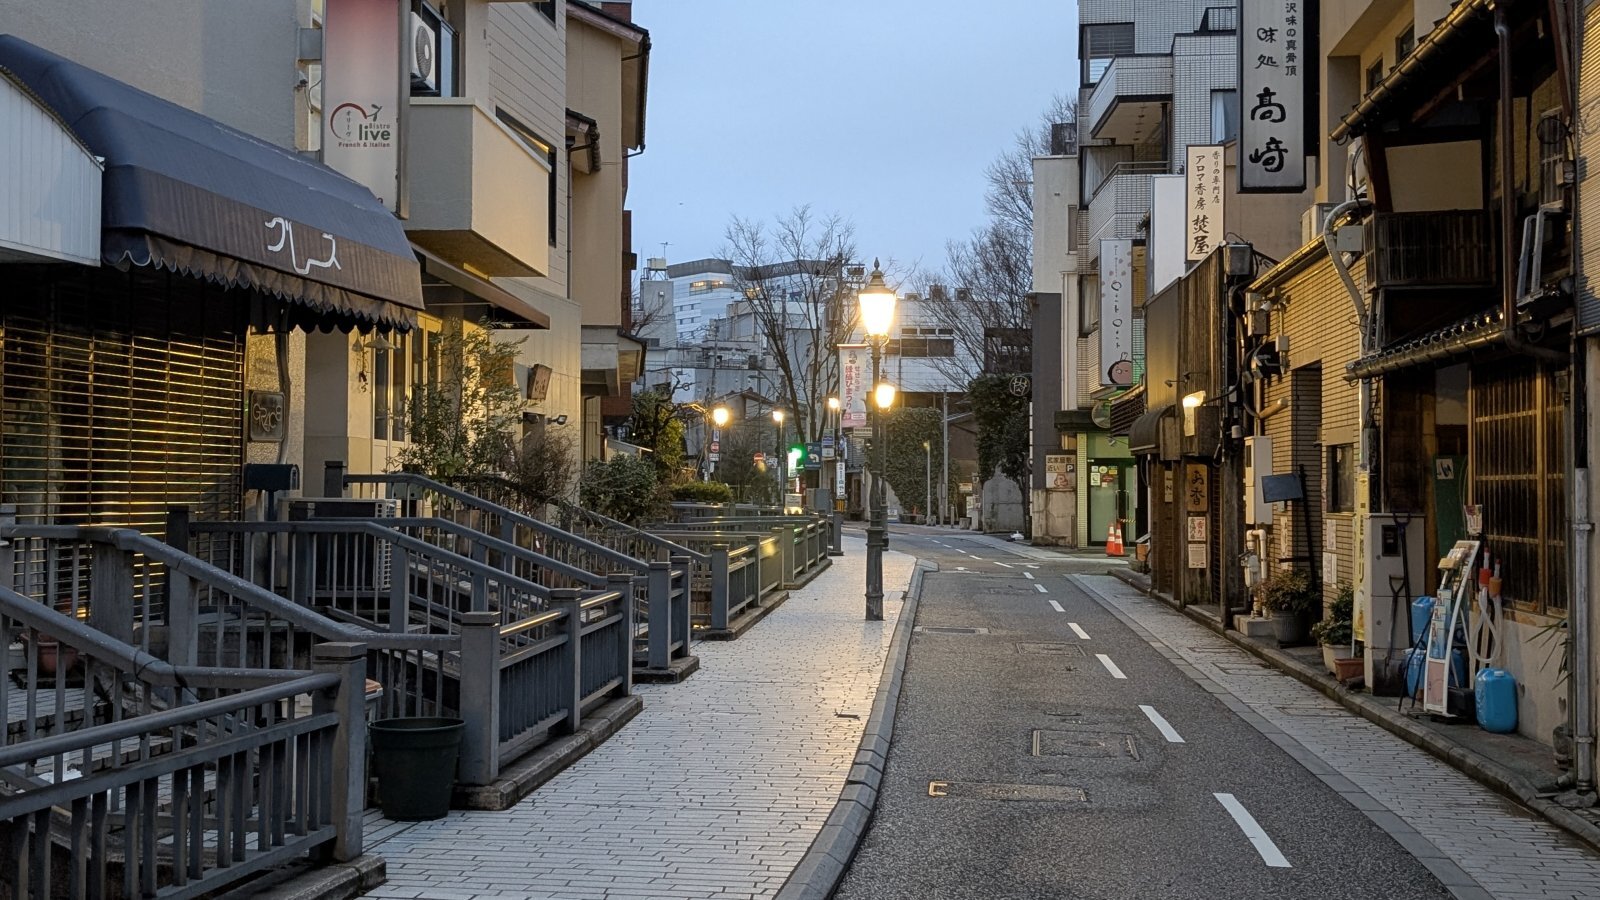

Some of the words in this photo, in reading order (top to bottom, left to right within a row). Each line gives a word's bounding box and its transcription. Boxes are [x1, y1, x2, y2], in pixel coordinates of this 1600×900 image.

[1285, 0, 1297, 76] 沢味の真骨頂
